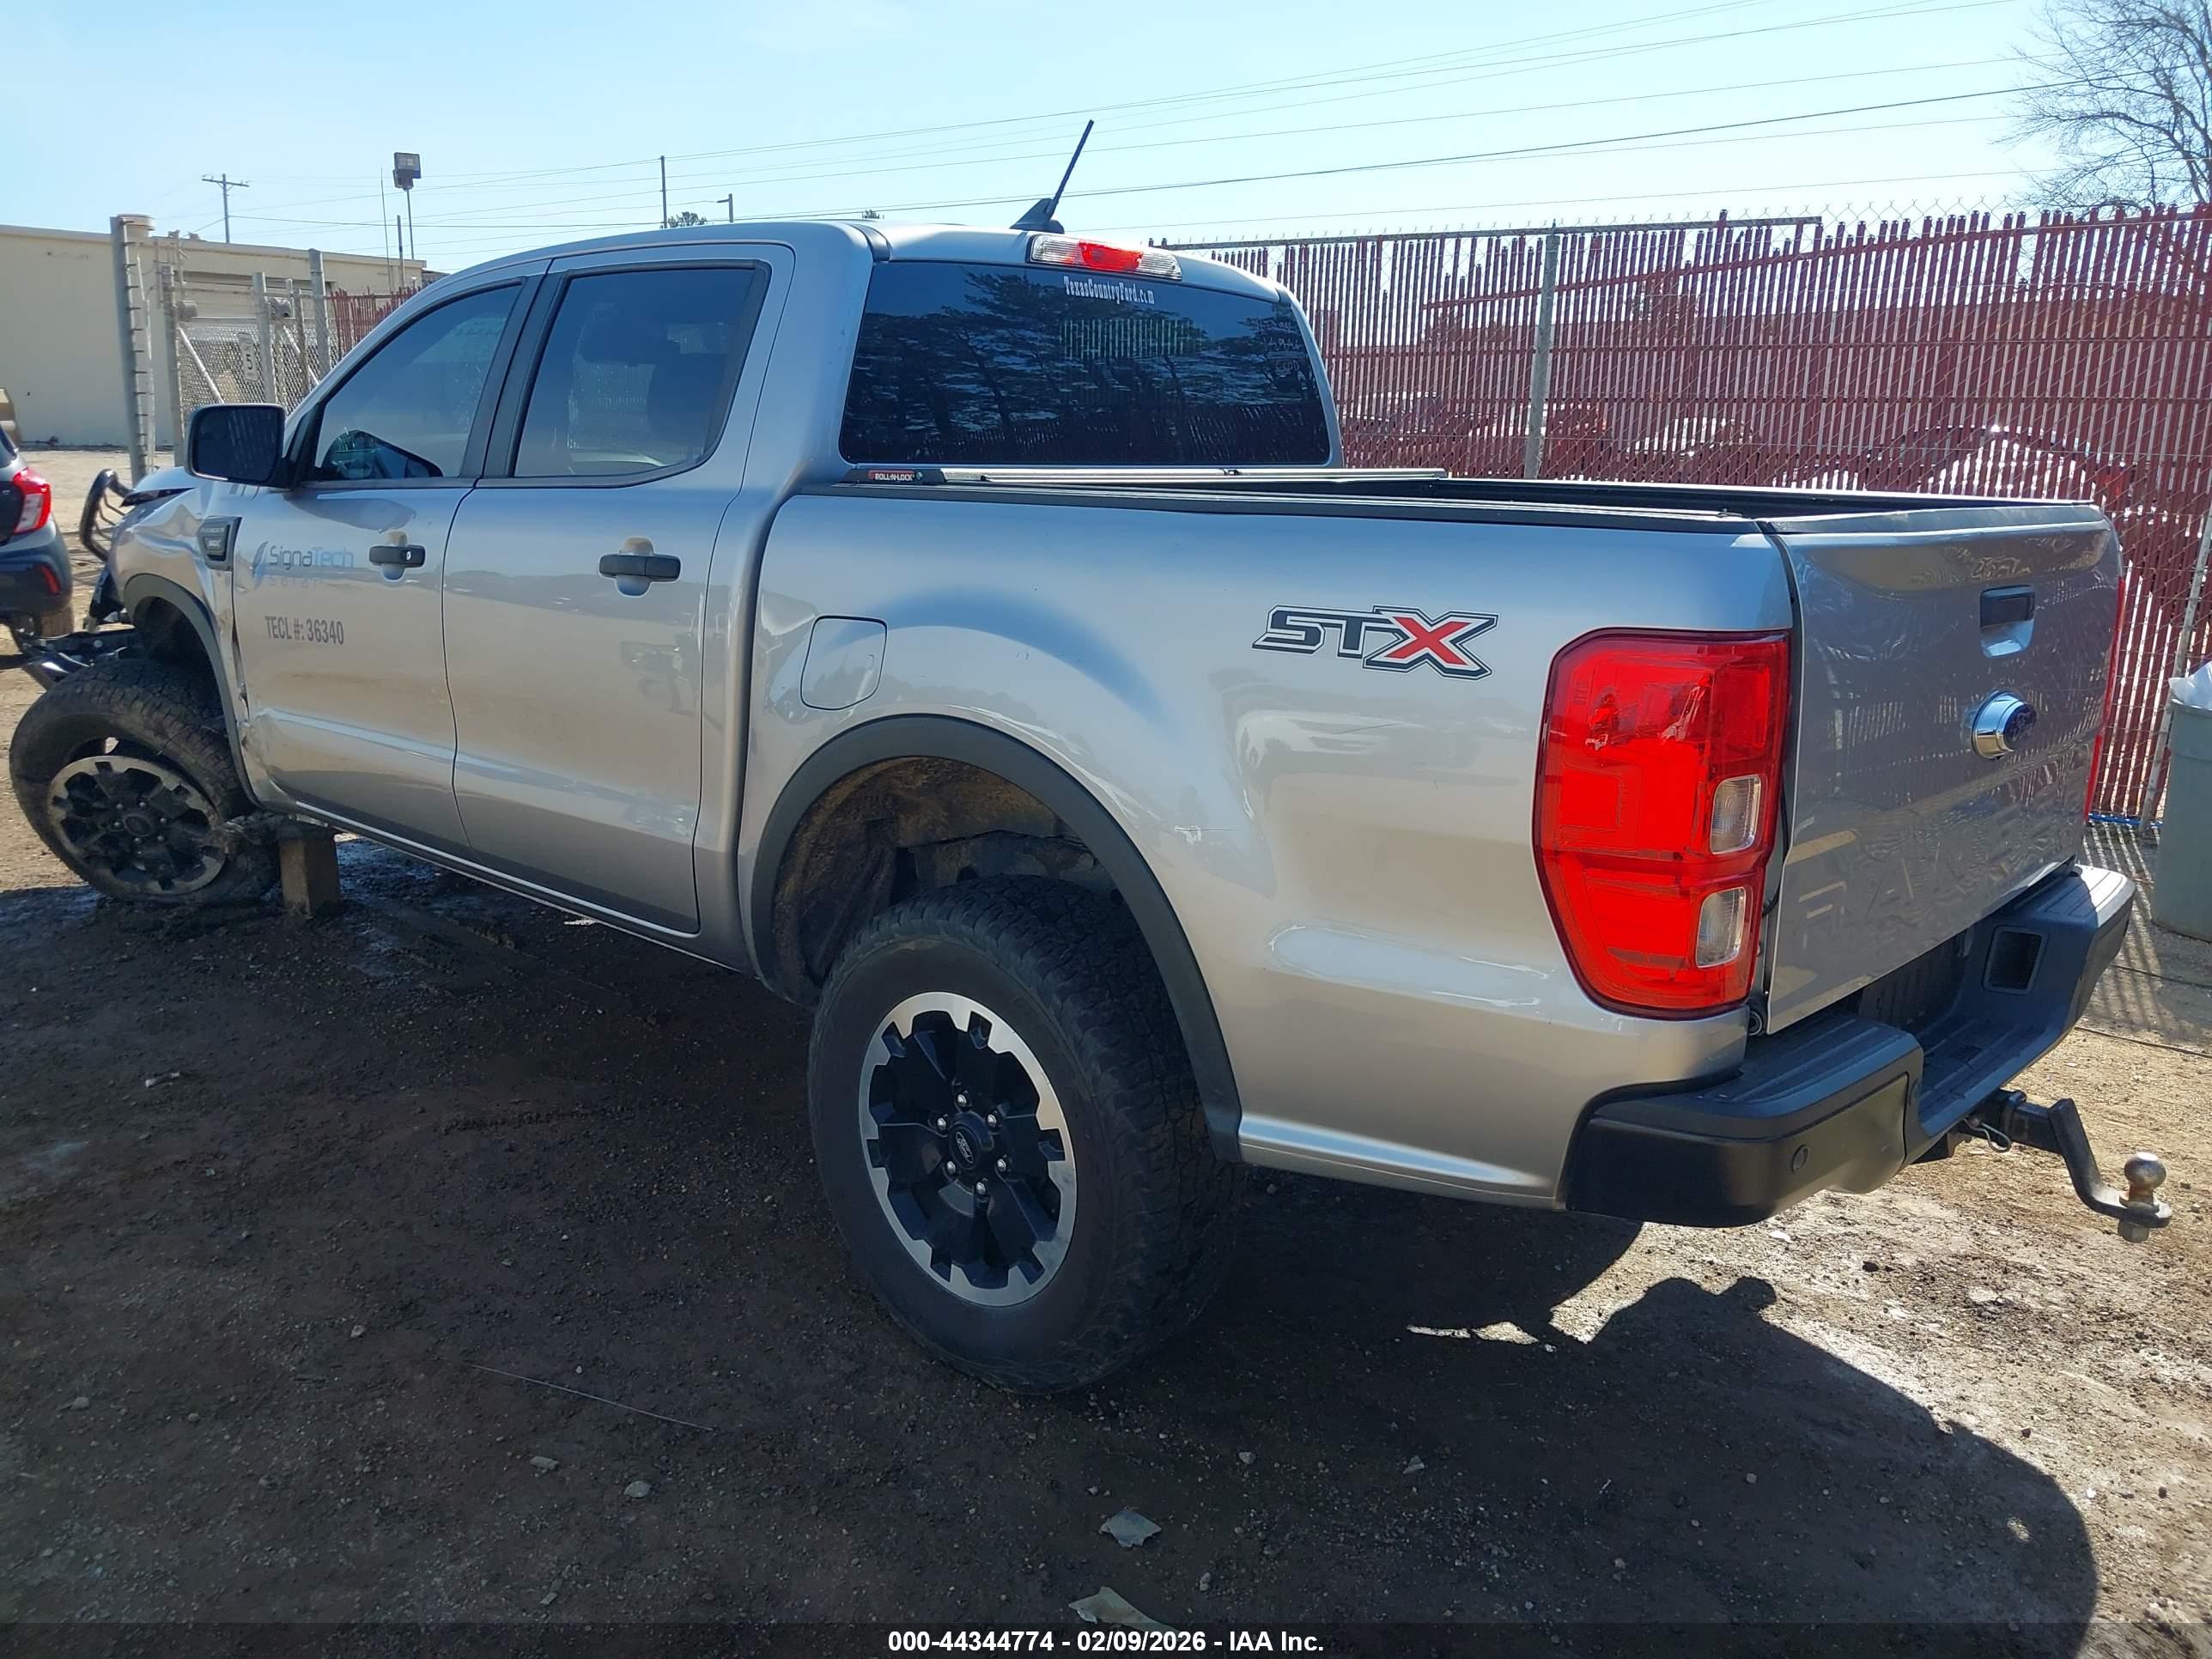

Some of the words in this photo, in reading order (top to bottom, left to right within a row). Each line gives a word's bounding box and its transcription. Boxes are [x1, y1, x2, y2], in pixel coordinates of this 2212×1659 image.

[246, 353, 253, 370] 5
[269, 545, 355, 570] SignaTech
[264, 615, 293, 640] TECL
[293, 617, 305, 641] #:
[307, 617, 344, 645] 36340
[1252, 604, 1499, 682] STX
